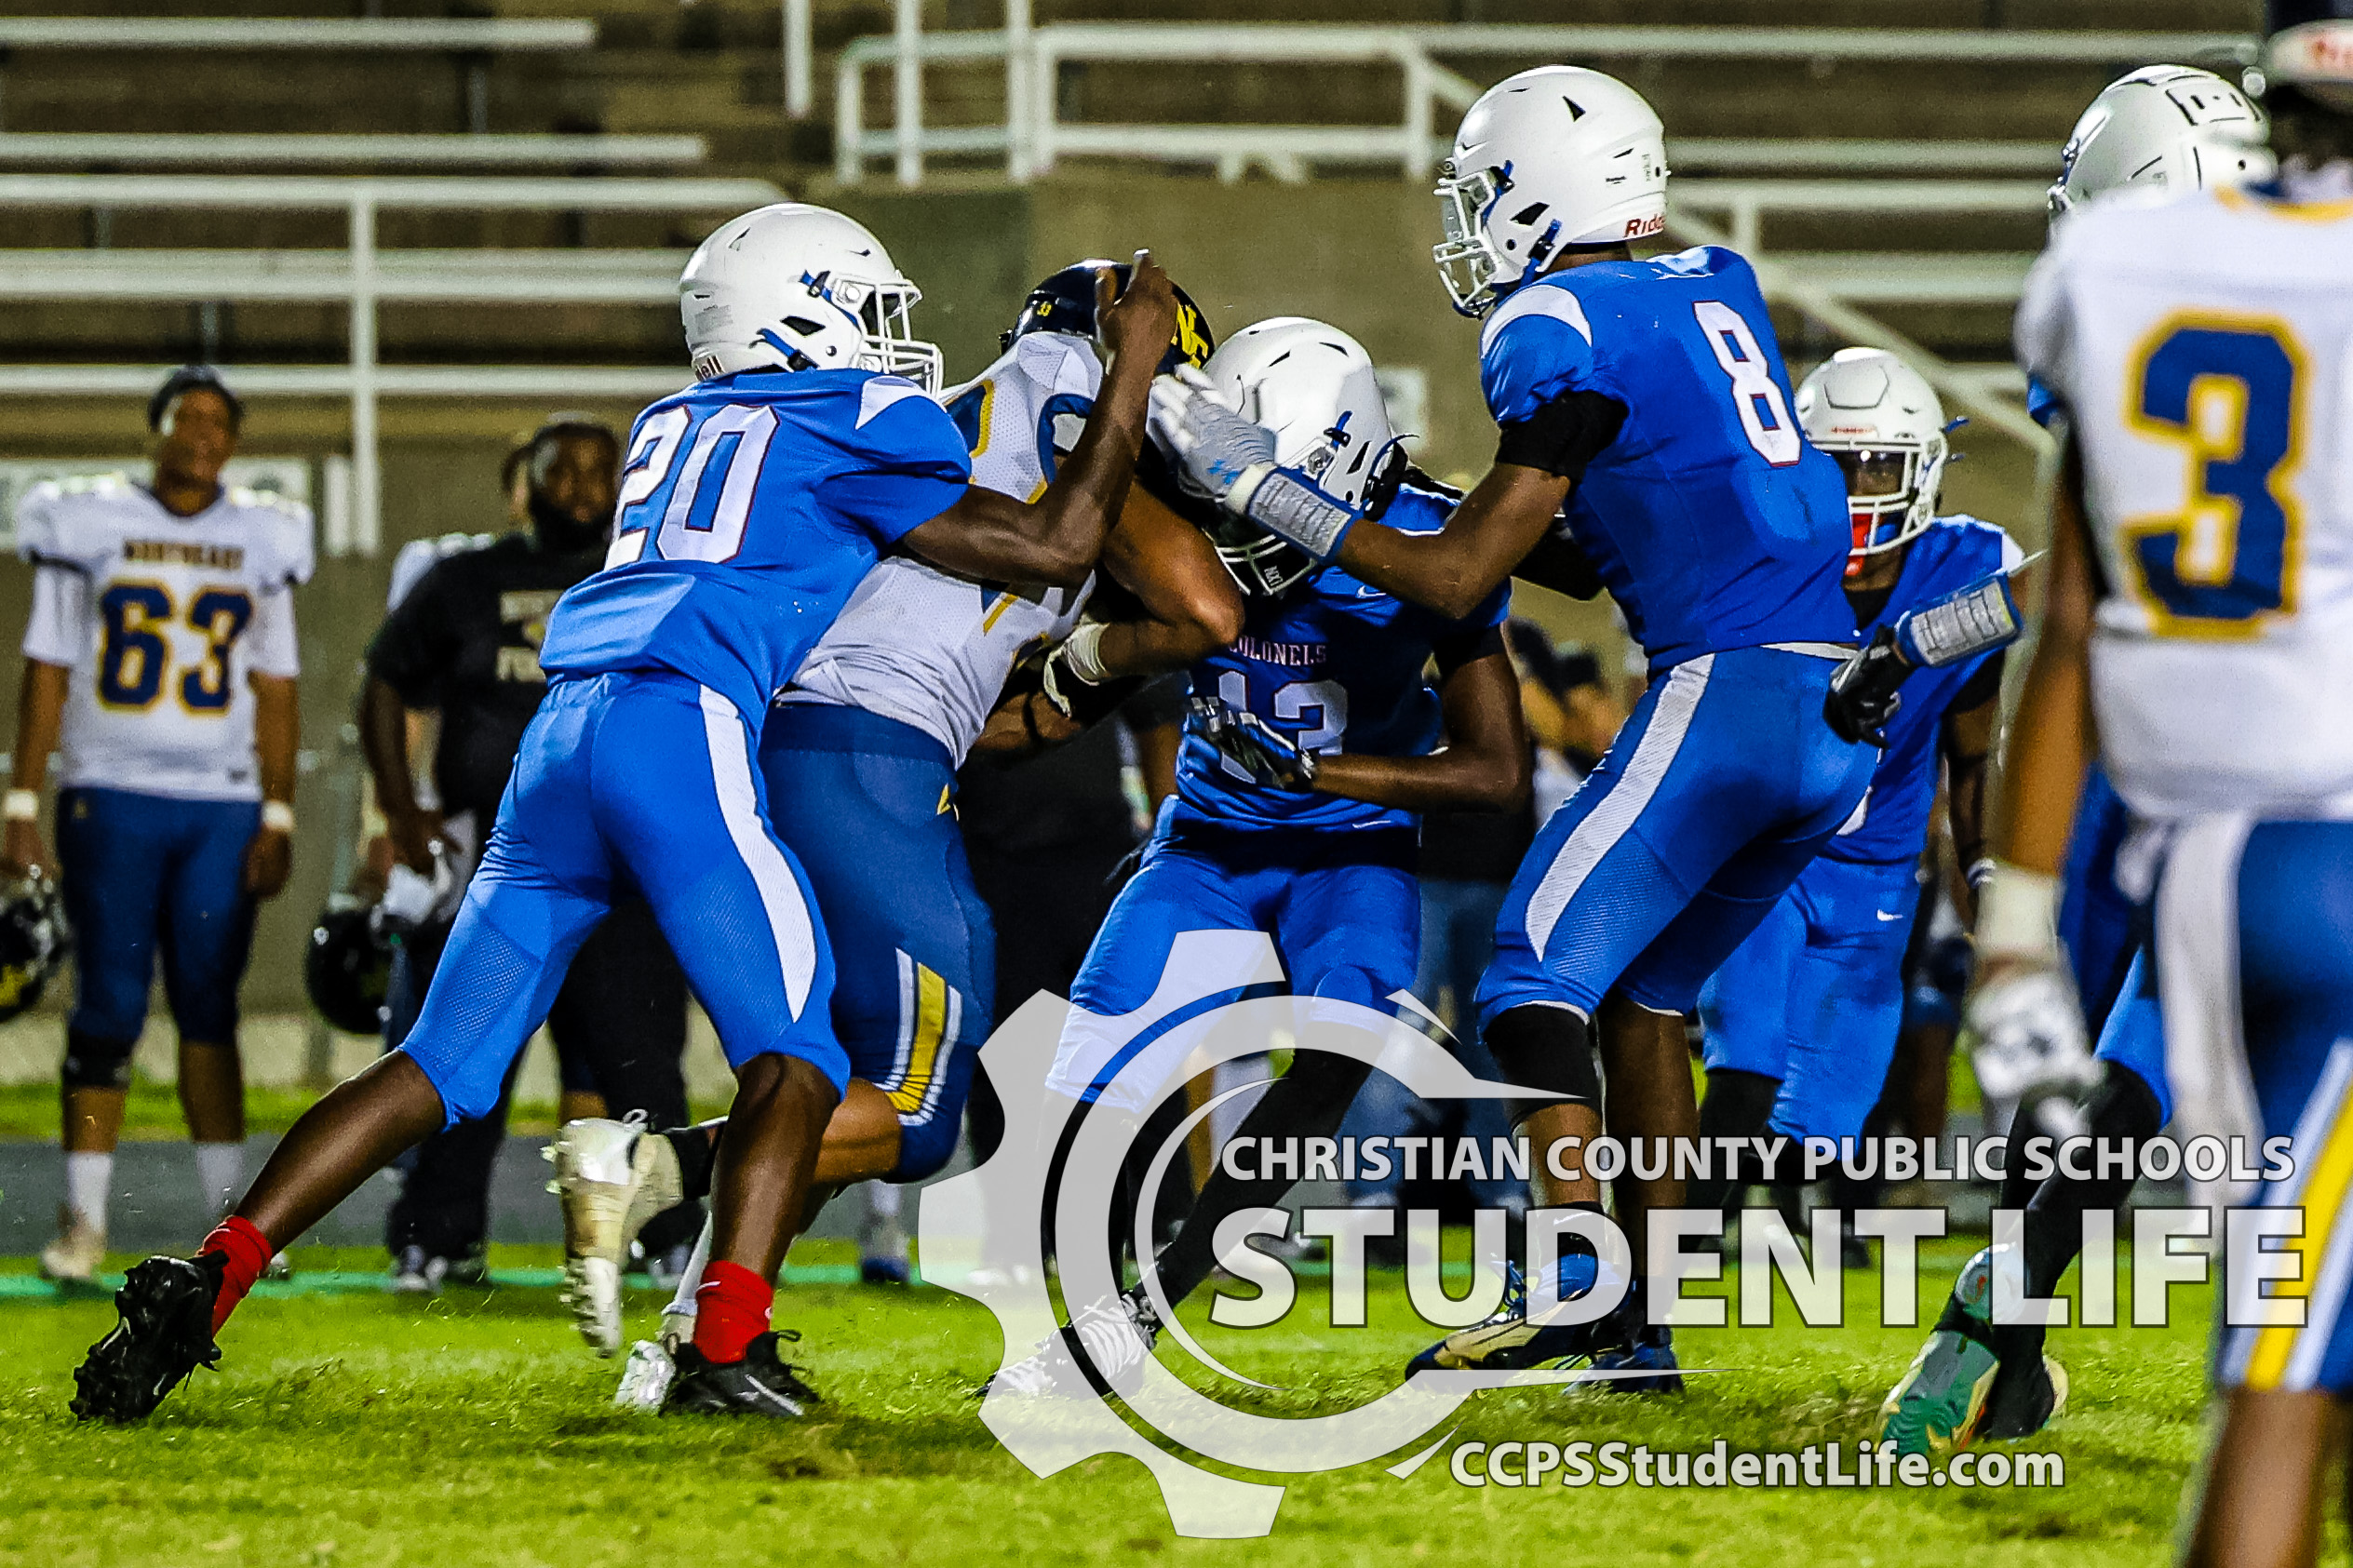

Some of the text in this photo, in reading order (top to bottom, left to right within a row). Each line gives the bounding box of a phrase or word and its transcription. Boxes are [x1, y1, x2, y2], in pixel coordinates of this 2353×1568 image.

[1692, 300, 1802, 467] 8
[604, 403, 780, 571] 20
[2119, 308, 2315, 640] 3
[97, 579, 252, 717] 63
